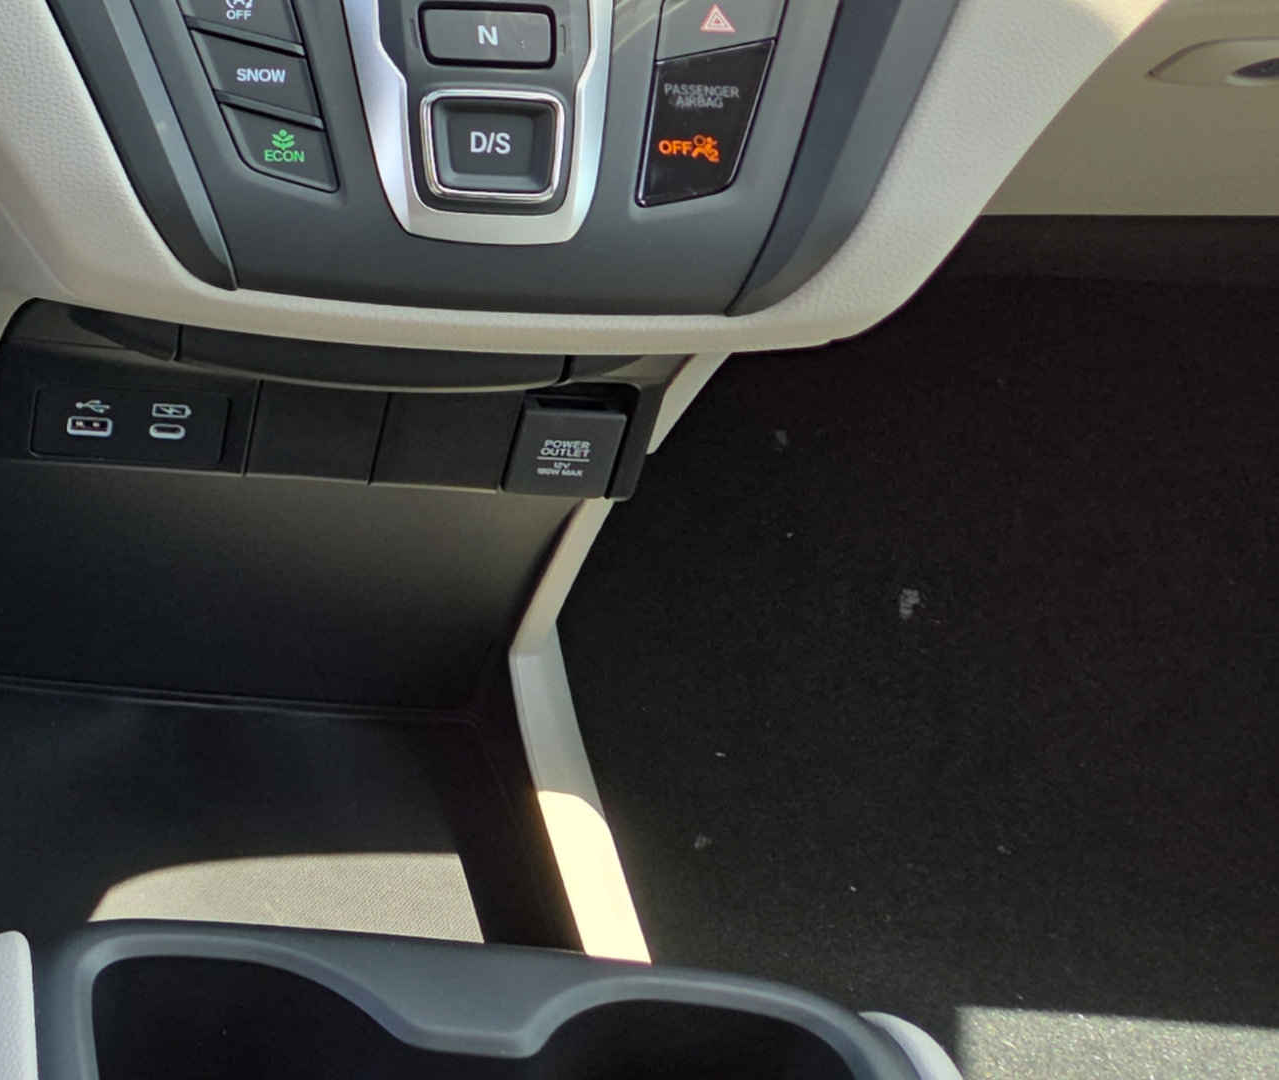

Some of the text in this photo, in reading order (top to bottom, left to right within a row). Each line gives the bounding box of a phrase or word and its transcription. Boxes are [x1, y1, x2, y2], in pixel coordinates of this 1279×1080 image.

[226, 10, 252, 20] OFF
[477, 25, 498, 46] N
[236, 68, 286, 84] SNOW
[664, 83, 740, 98] PASSENGER
[676, 95, 723, 108] AIRBAG
[470, 131, 511, 154] D/S
[658, 140, 692, 156] OFF
[264, 149, 305, 163] ECON
[544, 439, 590, 450] POWER
[540, 447, 591, 458] OUTLET
